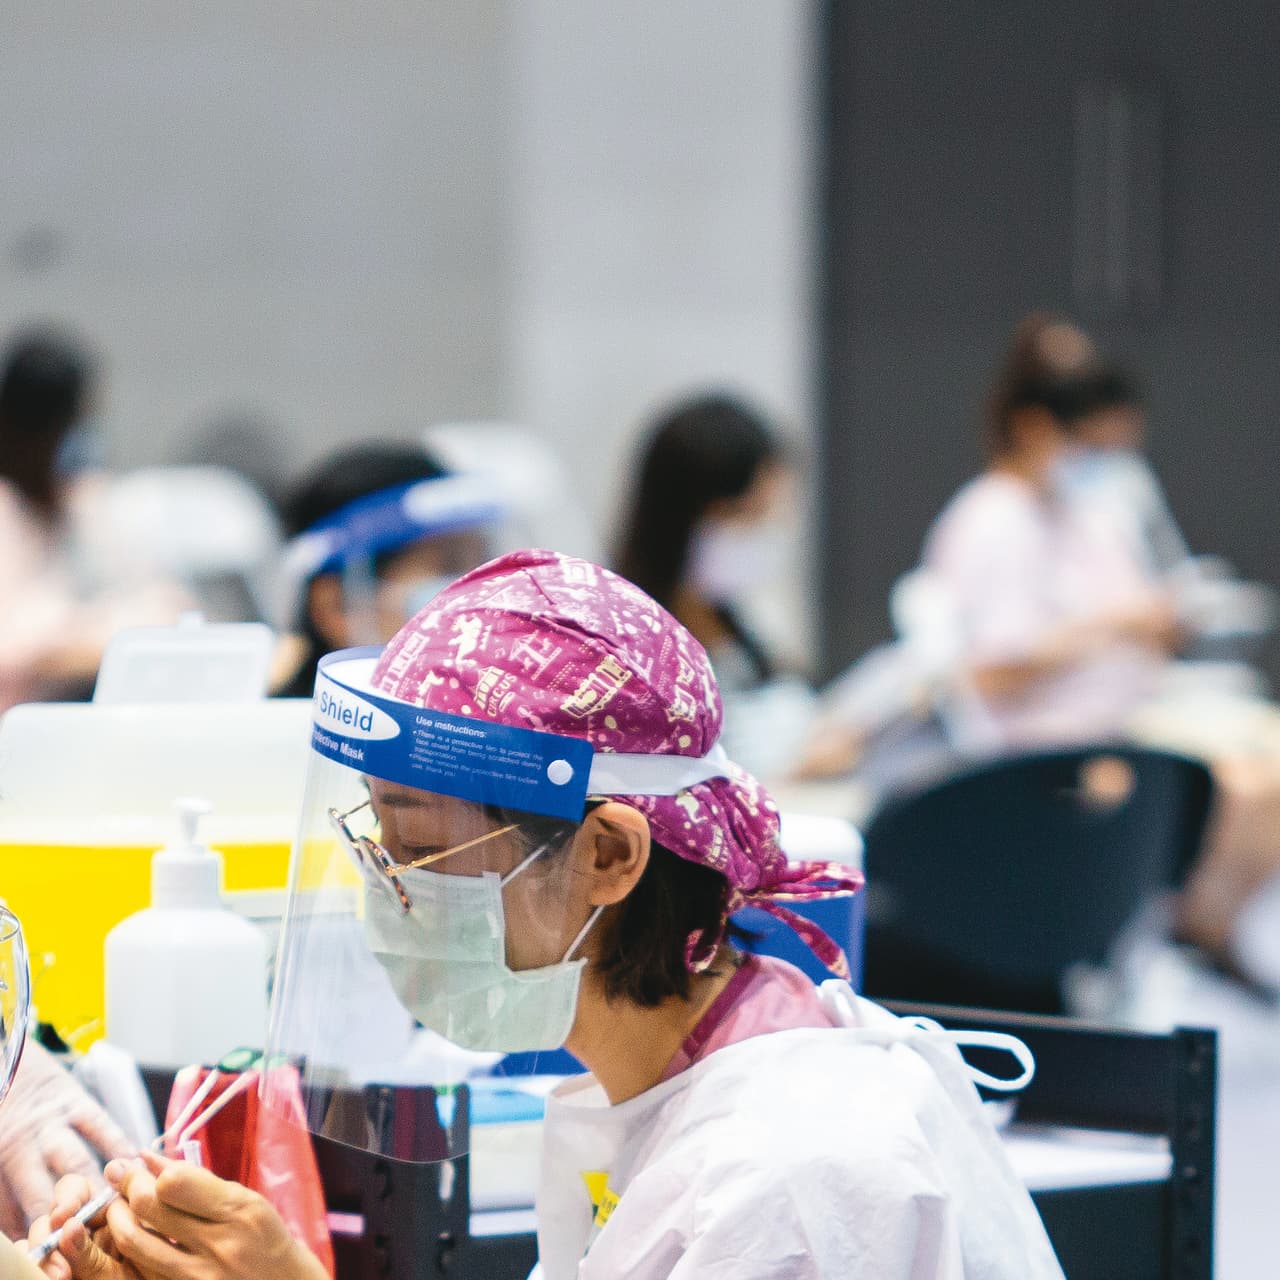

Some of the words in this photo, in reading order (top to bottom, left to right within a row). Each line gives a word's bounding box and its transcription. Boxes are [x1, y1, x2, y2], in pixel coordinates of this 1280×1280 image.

[487, 672, 518, 717] CIRCUS
[320, 690, 373, 732] Shield
[416, 715, 433, 727] Use
[340, 741, 365, 761] Mask
